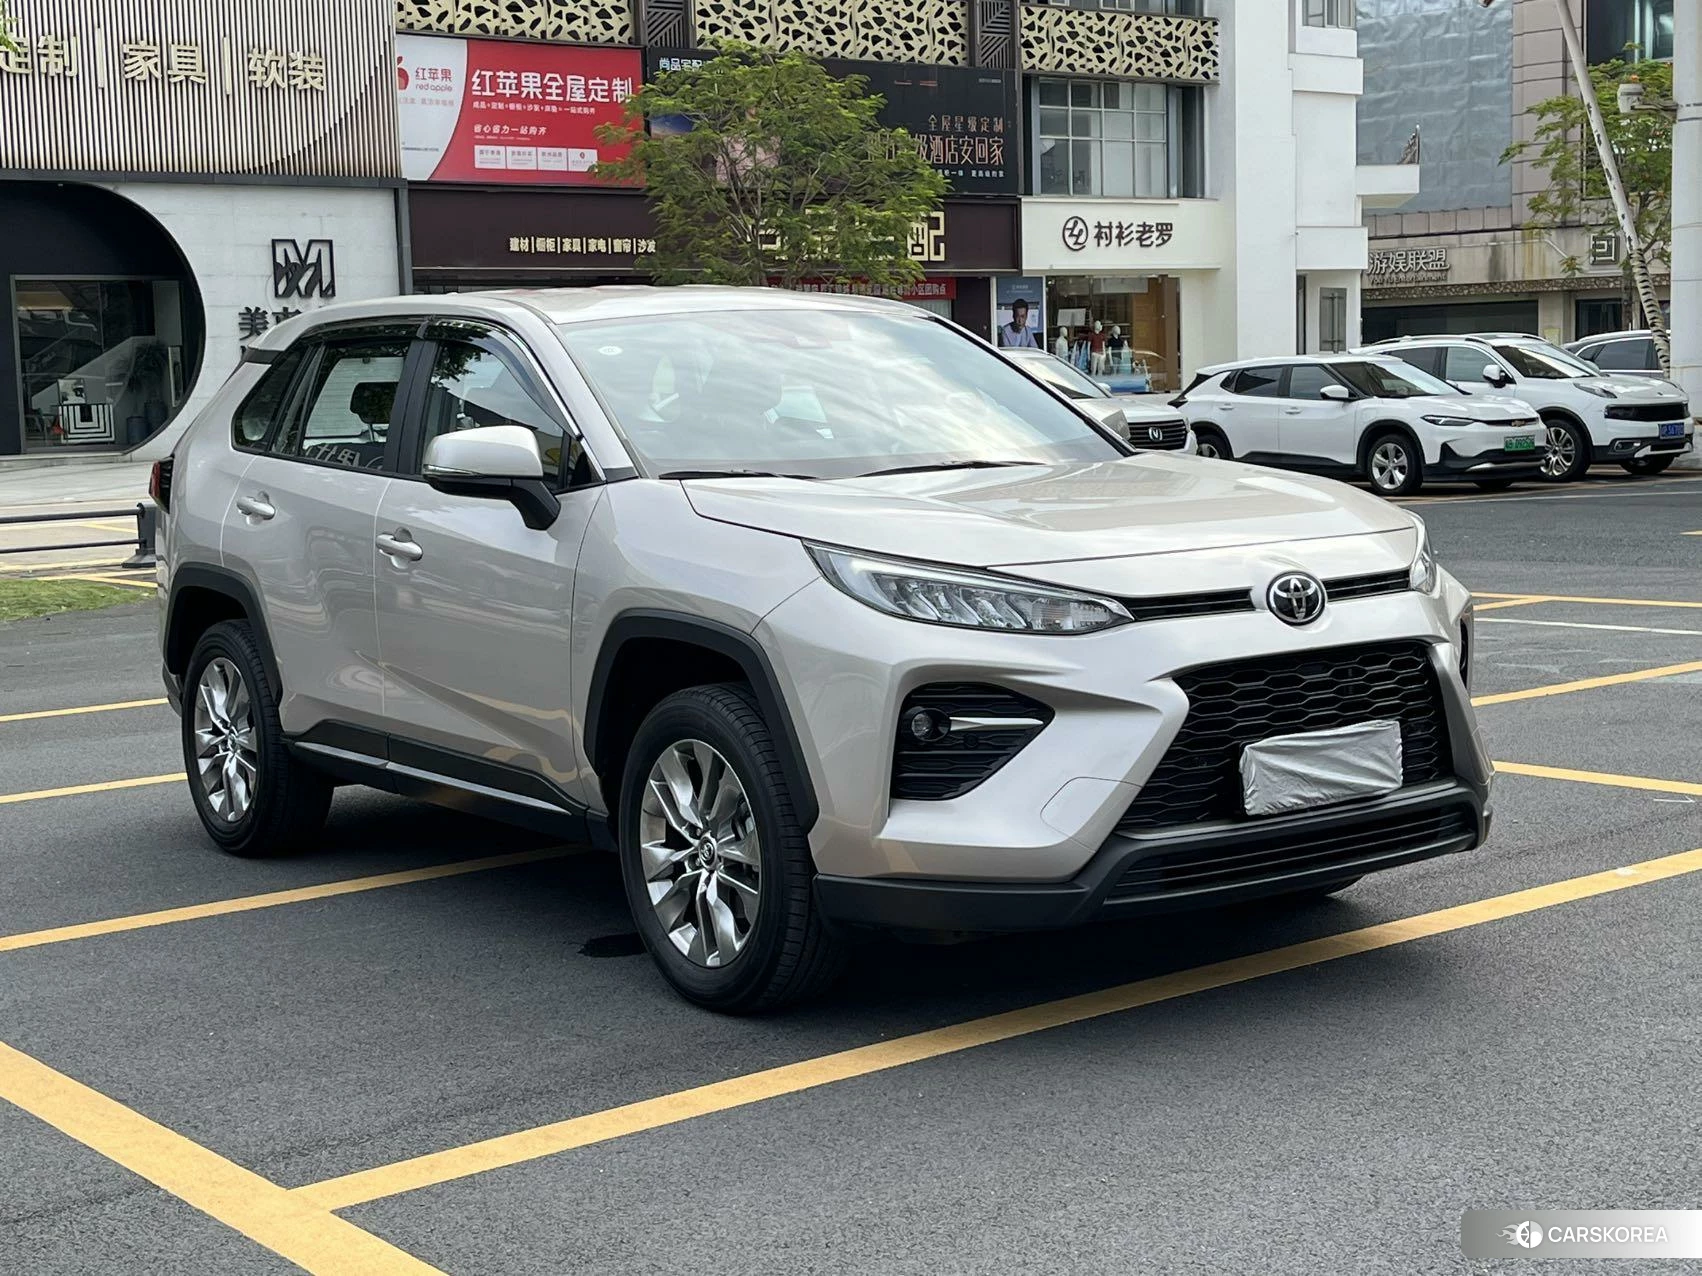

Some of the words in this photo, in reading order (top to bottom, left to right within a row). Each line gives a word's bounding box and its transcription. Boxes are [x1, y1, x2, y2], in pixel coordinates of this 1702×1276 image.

[122, 40, 207, 84] 家具
[247, 48, 325, 91] 软装
[415, 67, 452, 82] 红苹果
[471, 69, 633, 103] 红苹果全屋定制
[928, 114, 1004, 134] 全屋星级定制
[1094, 220, 1173, 248] 衬衫老罗
[1366, 248, 1450, 274] 游娱联盟
